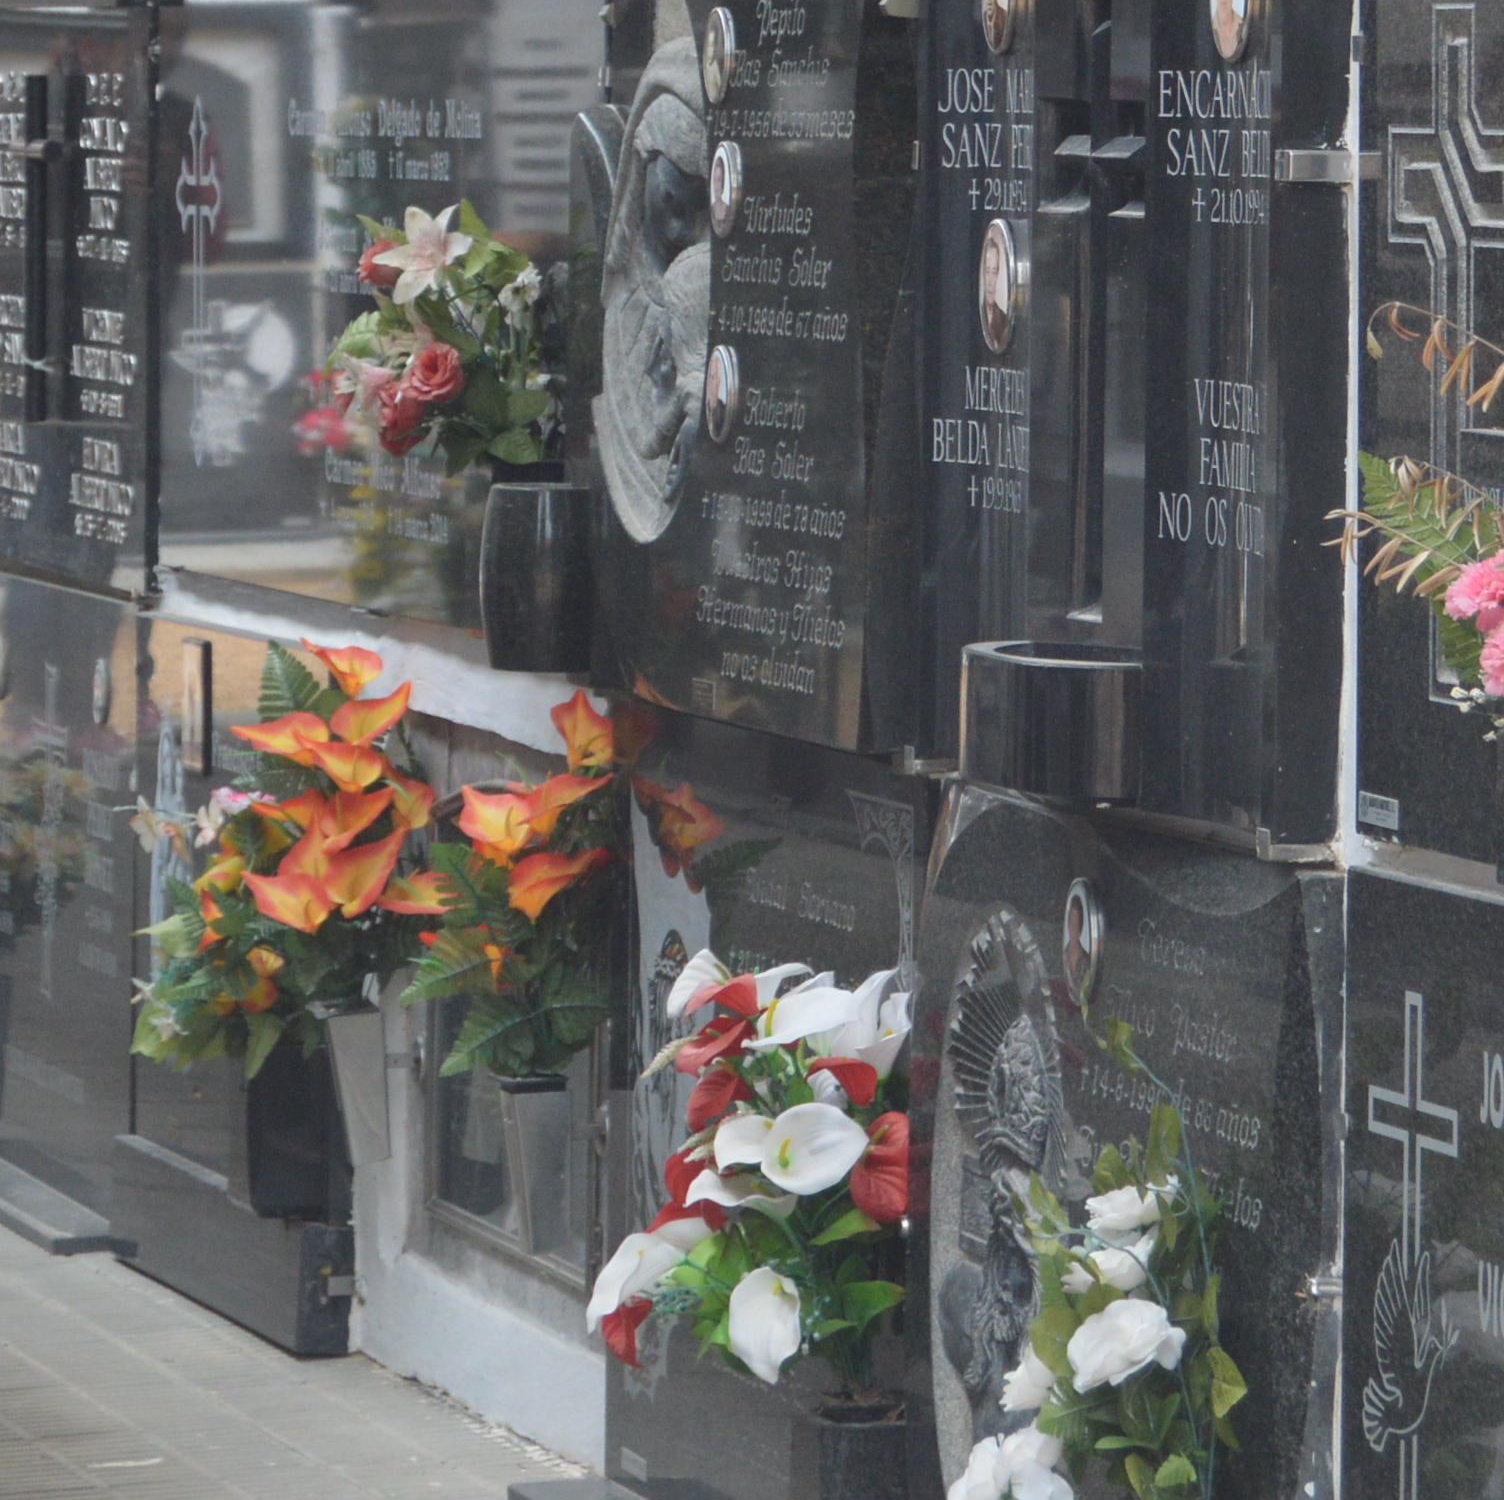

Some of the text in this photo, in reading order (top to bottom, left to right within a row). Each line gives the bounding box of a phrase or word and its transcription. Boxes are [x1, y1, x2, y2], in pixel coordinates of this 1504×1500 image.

[938, 67, 995, 114] JOSE
[803, 110, 855, 139] meses
[941, 123, 1002, 169] SANZ
[1166, 130, 1231, 176] SANZ
[744, 194, 812, 234] Virtudes
[722, 244, 831, 290] Sanchis Soler
[776, 297, 793, 336] de
[813, 307, 847, 342] años
[745, 387, 805, 431] Roberto
[1195, 378, 1260, 436] VUESTRA
[772, 441, 814, 482] Soler
[932, 419, 990, 465] BELDA
[1199, 438, 1256, 493] FAMILIA
[775, 489, 790, 530] de
[810, 502, 845, 539] años
[1157, 492, 1228, 547] NO OS
[784, 550, 832, 600] Hijos
[697, 585, 845, 649] Hermanos y Nietos
[721, 649, 814, 694] no os olvidan
[1216, 1102, 1261, 1151] años
